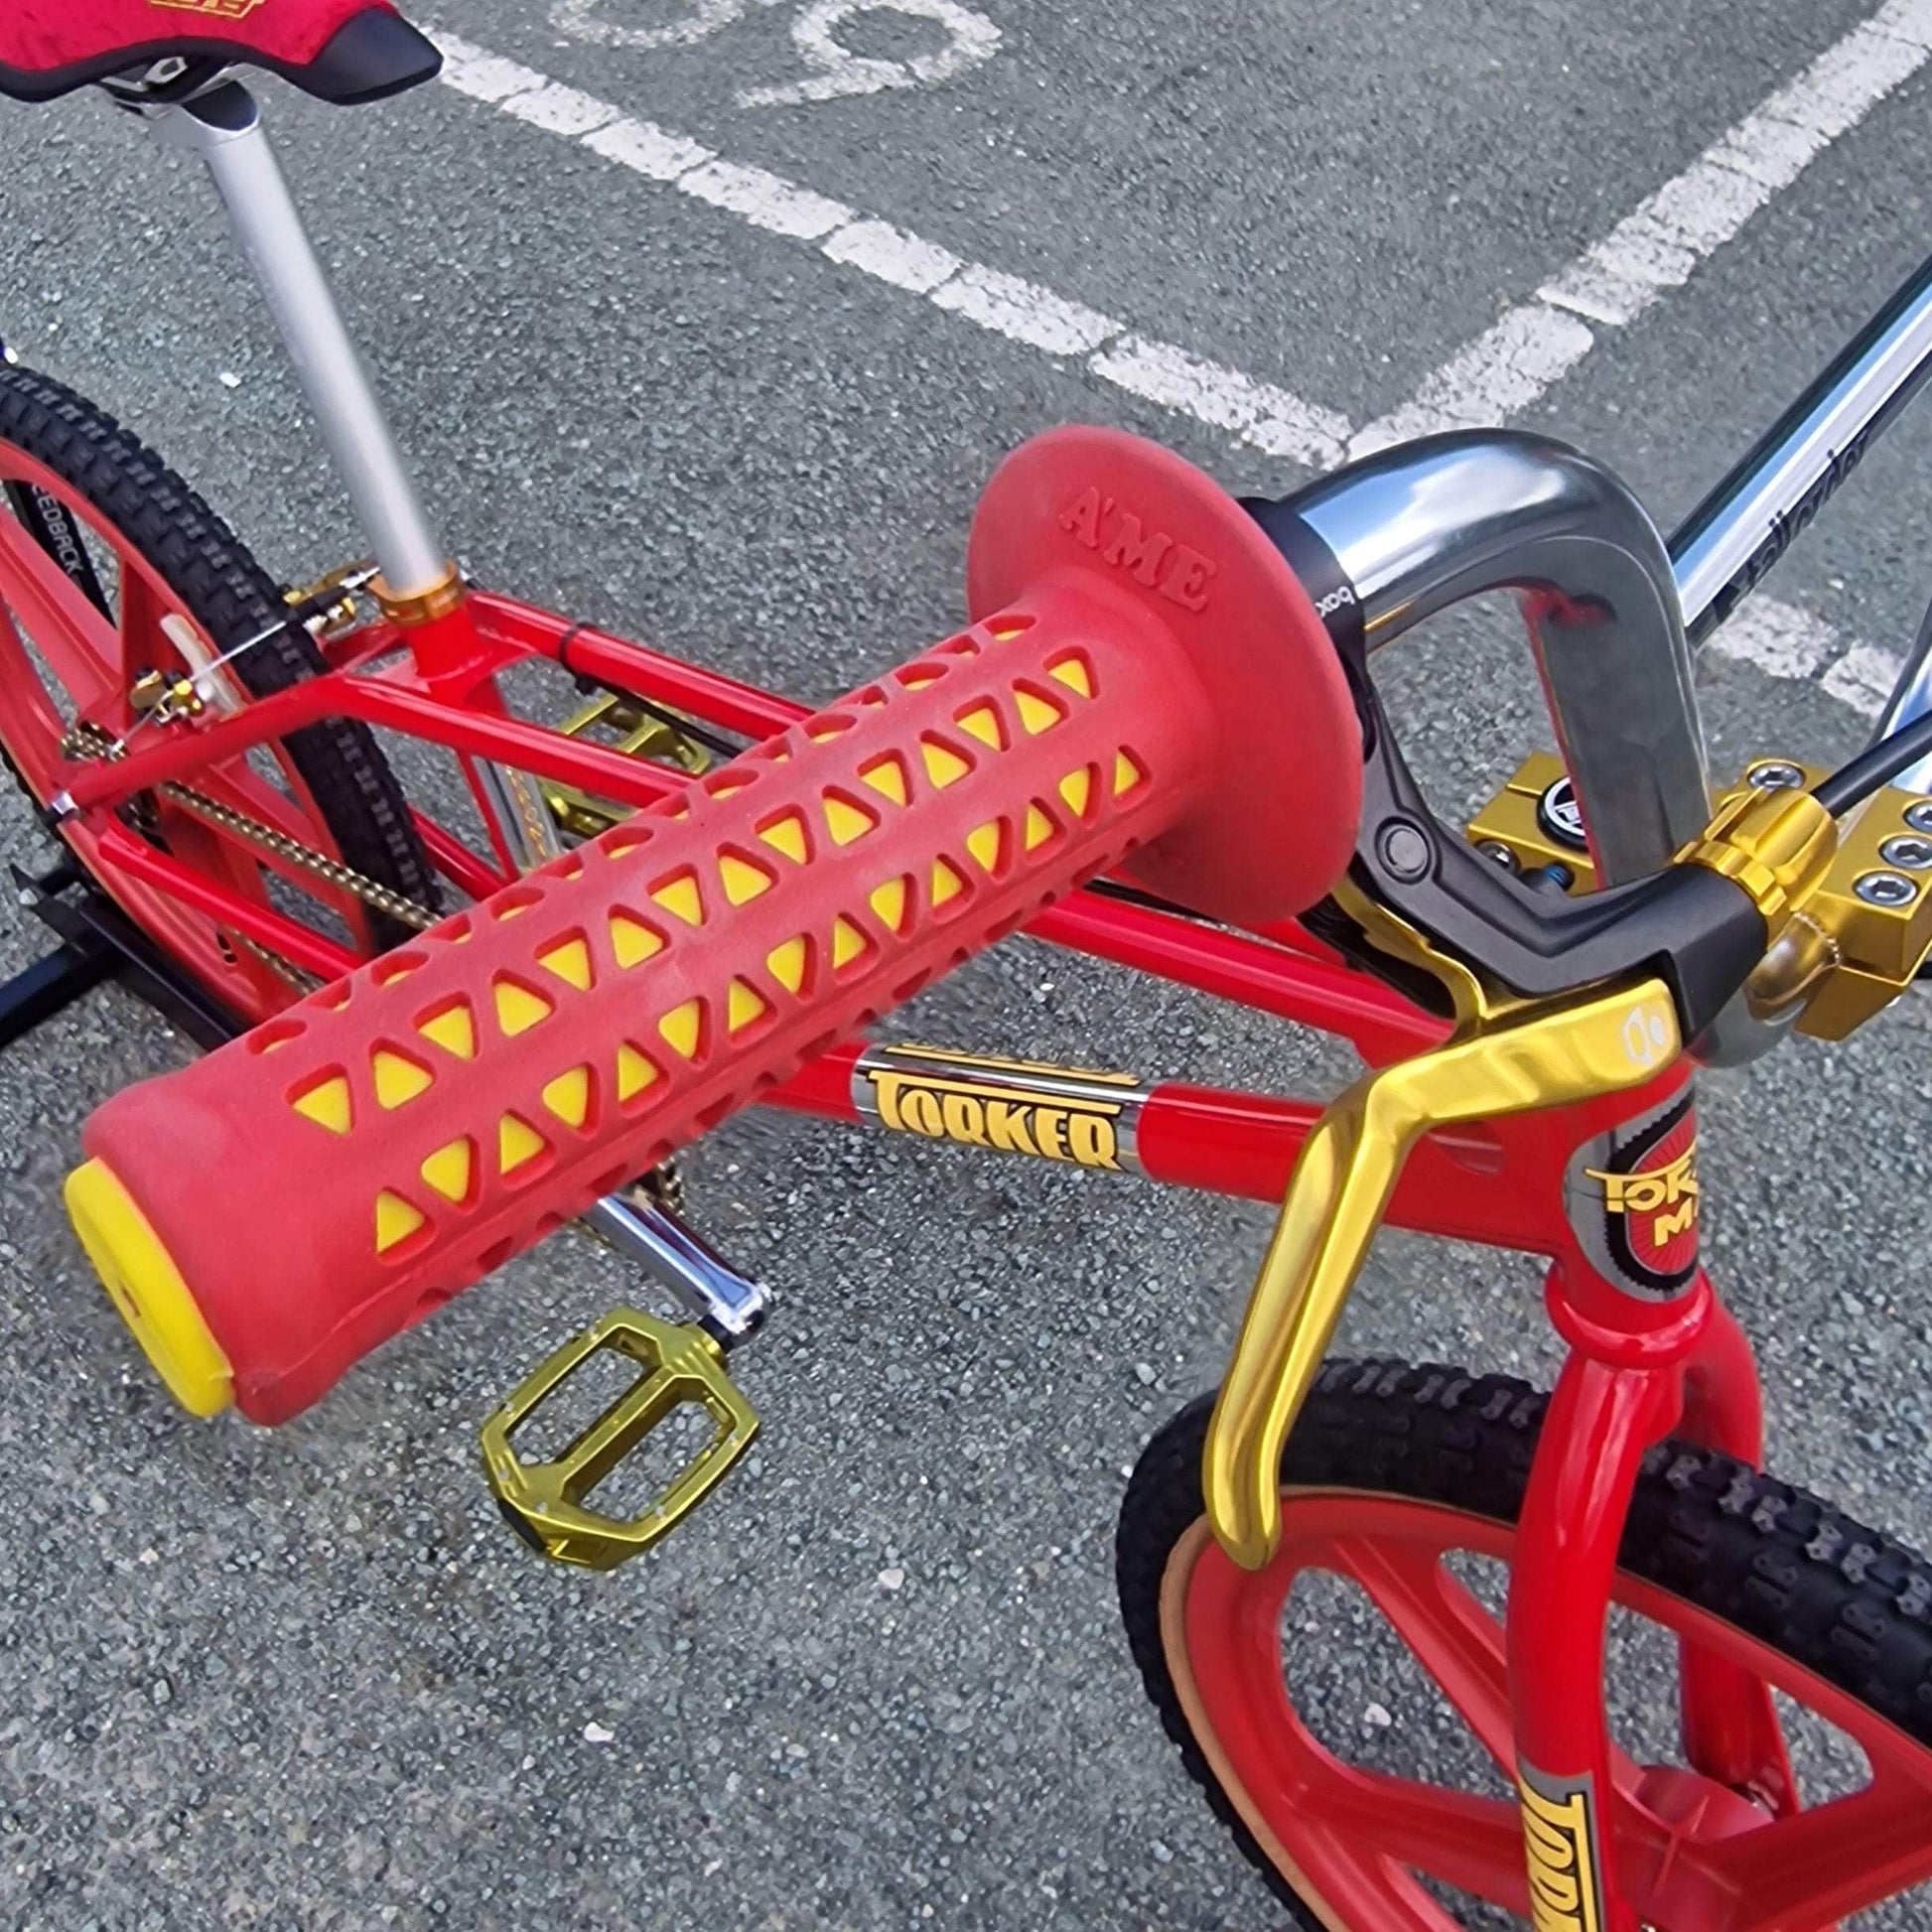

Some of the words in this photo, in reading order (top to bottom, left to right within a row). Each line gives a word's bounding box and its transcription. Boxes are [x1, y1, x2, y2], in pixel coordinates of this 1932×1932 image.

[1314, 586, 1355, 618] box
[869, 1069, 1124, 1172] TORKER
[1654, 1193, 1699, 1246] M
